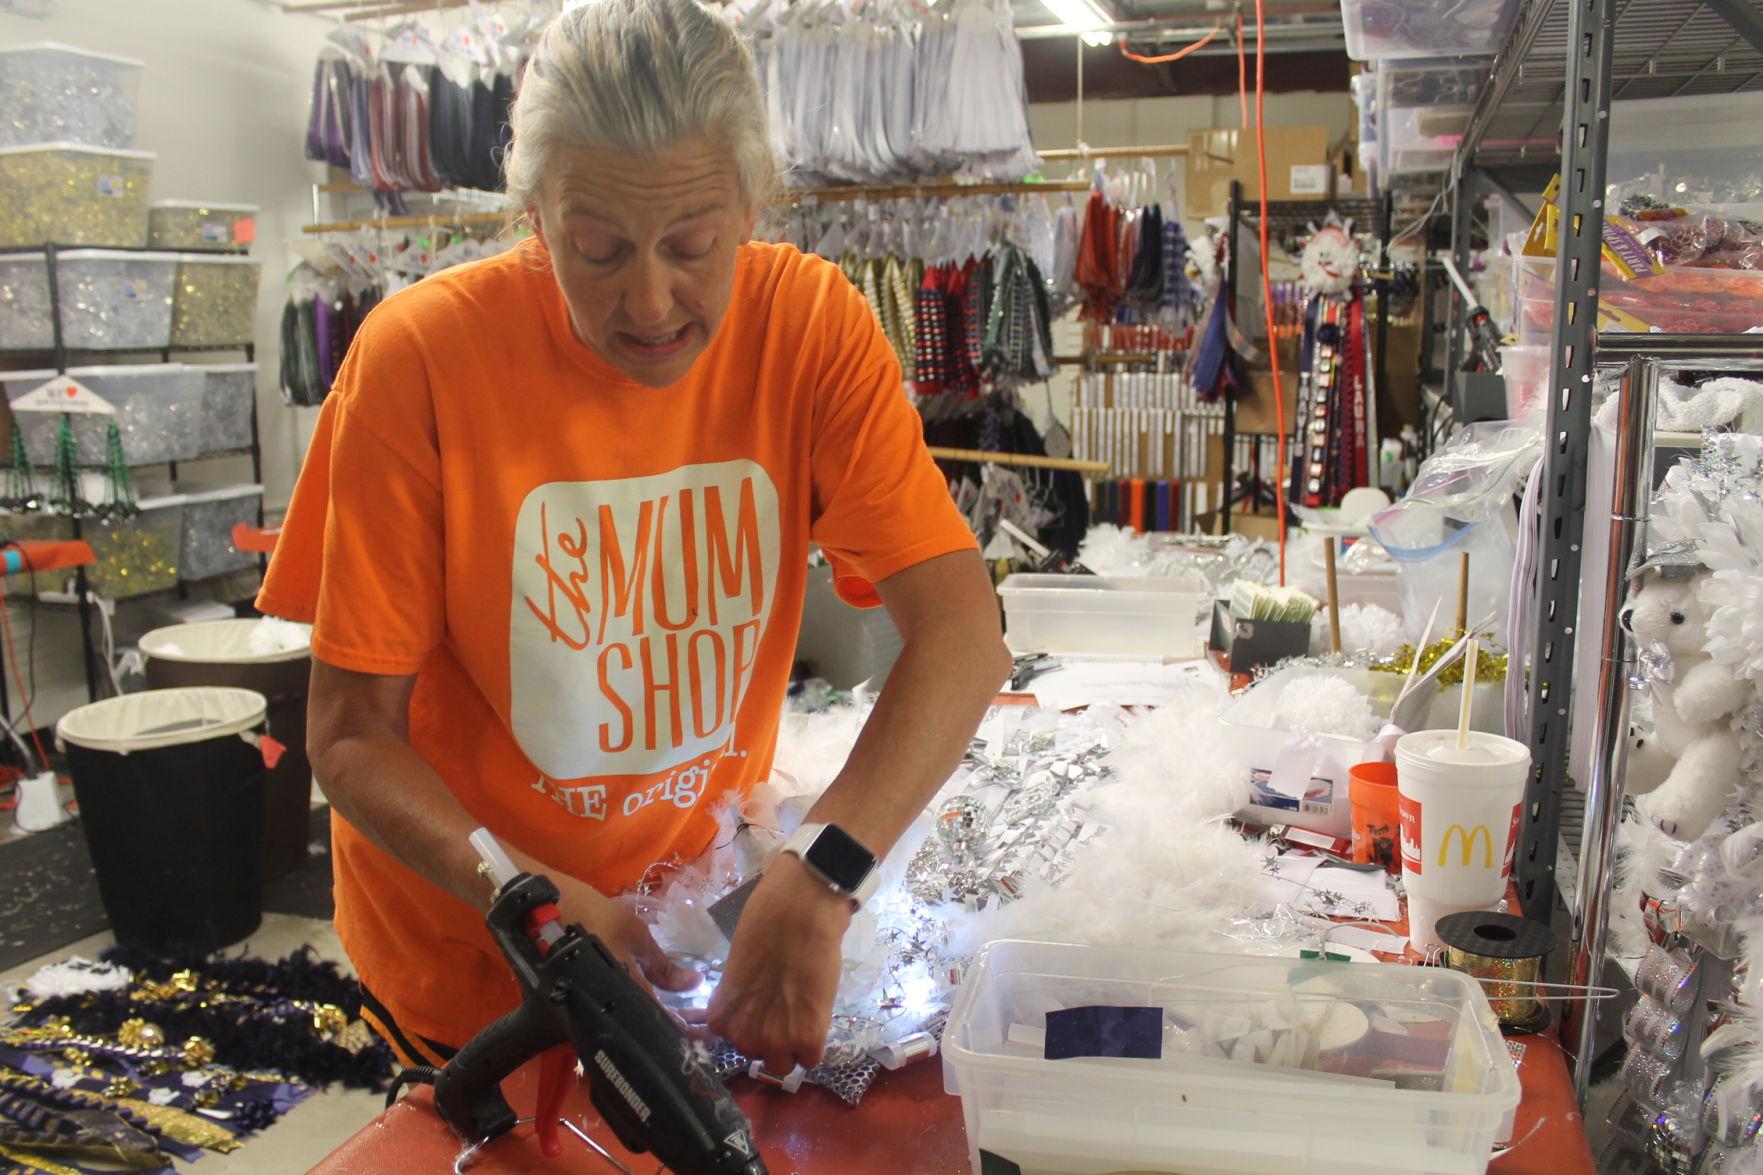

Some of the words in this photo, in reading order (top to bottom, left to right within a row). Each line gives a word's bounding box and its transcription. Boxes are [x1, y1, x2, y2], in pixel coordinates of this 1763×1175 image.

[1617, 249, 1648, 273] PARTY
[524, 500, 591, 651] the
[596, 476, 764, 646] MUM
[596, 619, 760, 753] SHOP
[595, 1049, 651, 1123] SUREBONDER
